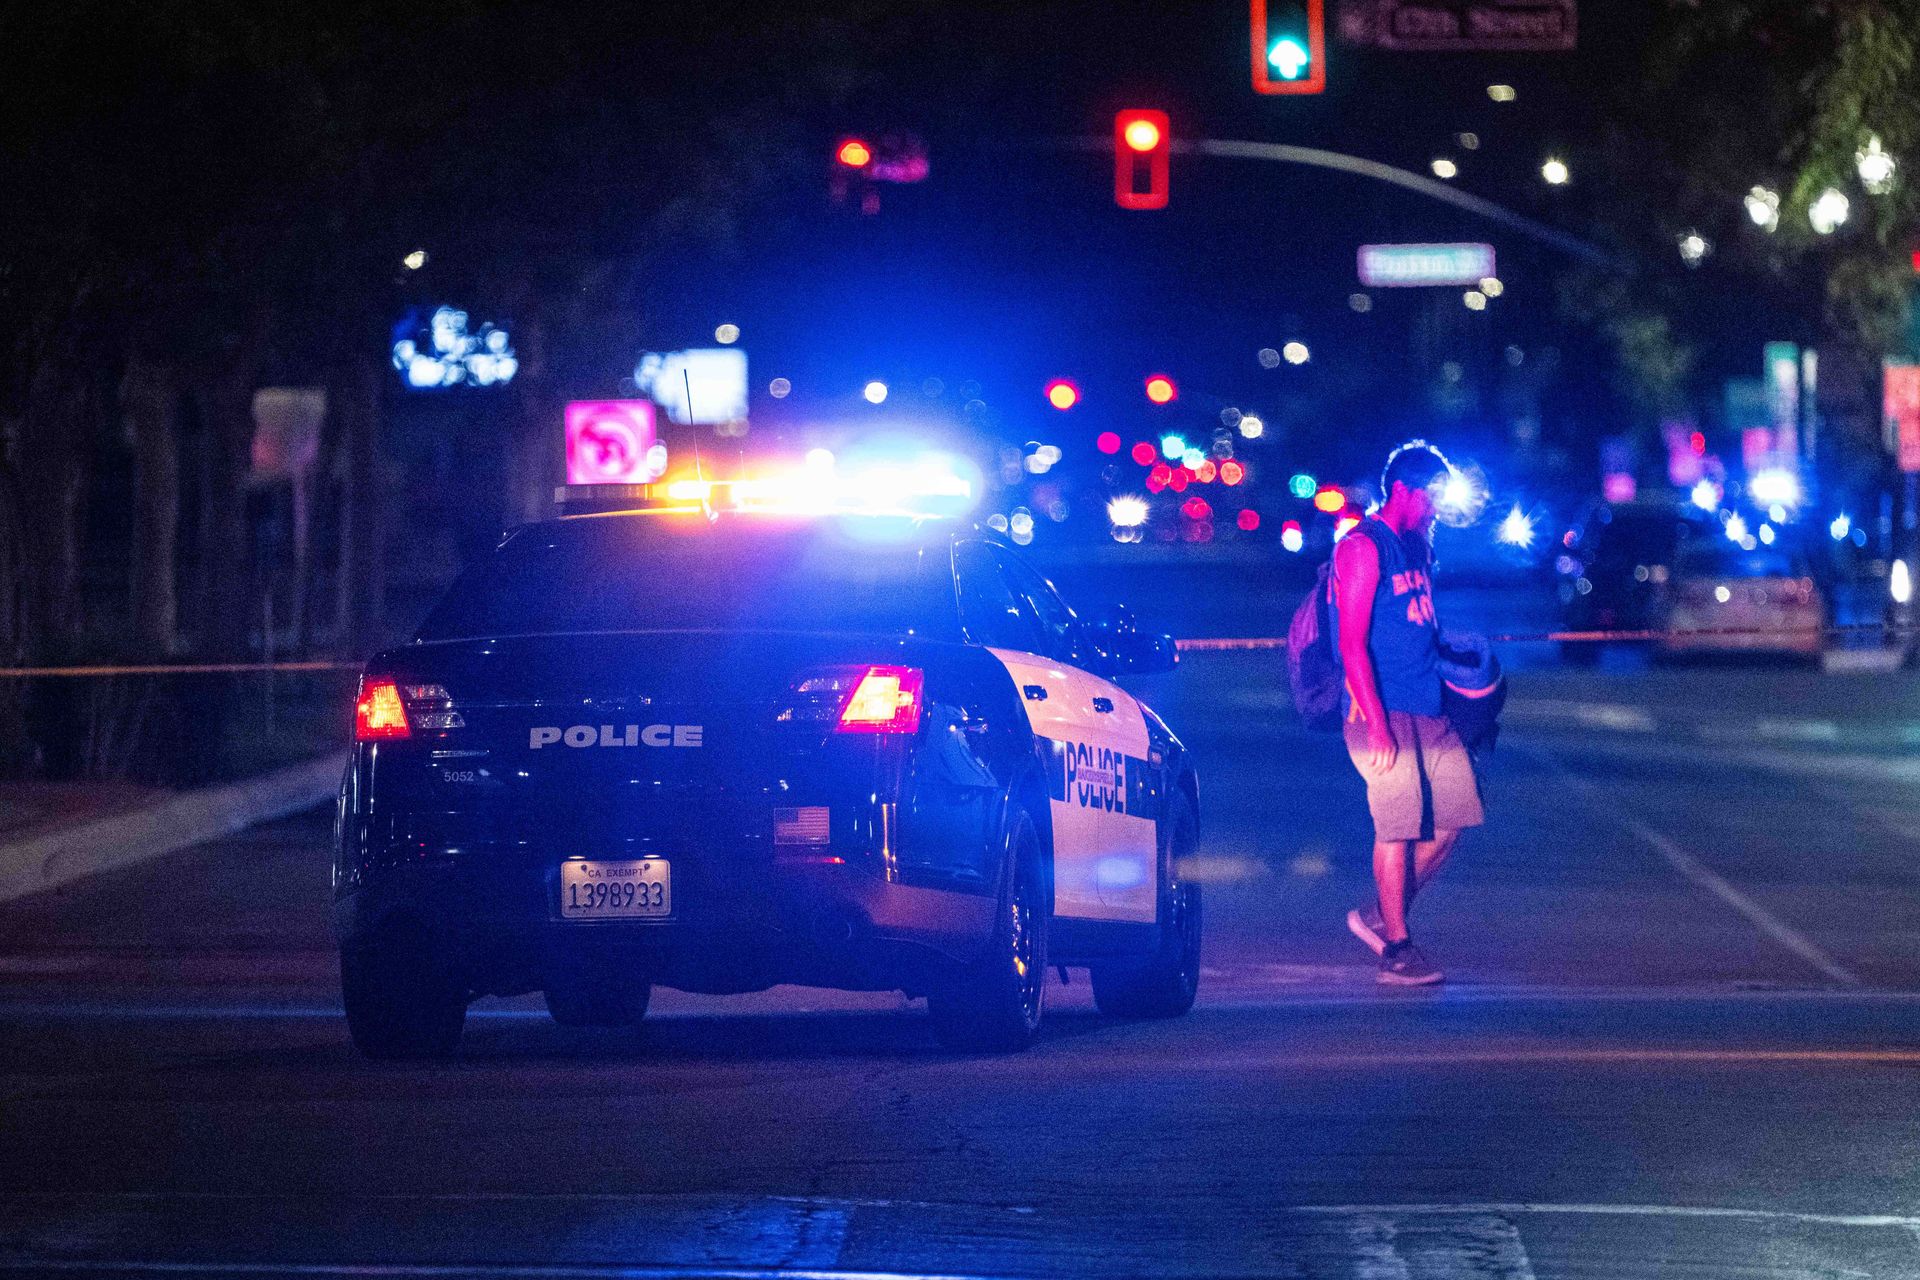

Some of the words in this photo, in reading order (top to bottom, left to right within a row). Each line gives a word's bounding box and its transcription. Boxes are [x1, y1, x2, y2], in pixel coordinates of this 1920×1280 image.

[529, 724, 704, 749] POLICE
[444, 771, 474, 782] 5052
[1066, 741, 1124, 814] POLICE
[588, 869, 601, 878] CA
[606, 868, 644, 878] EXEMPT
[569, 882, 664, 909] 1398933
